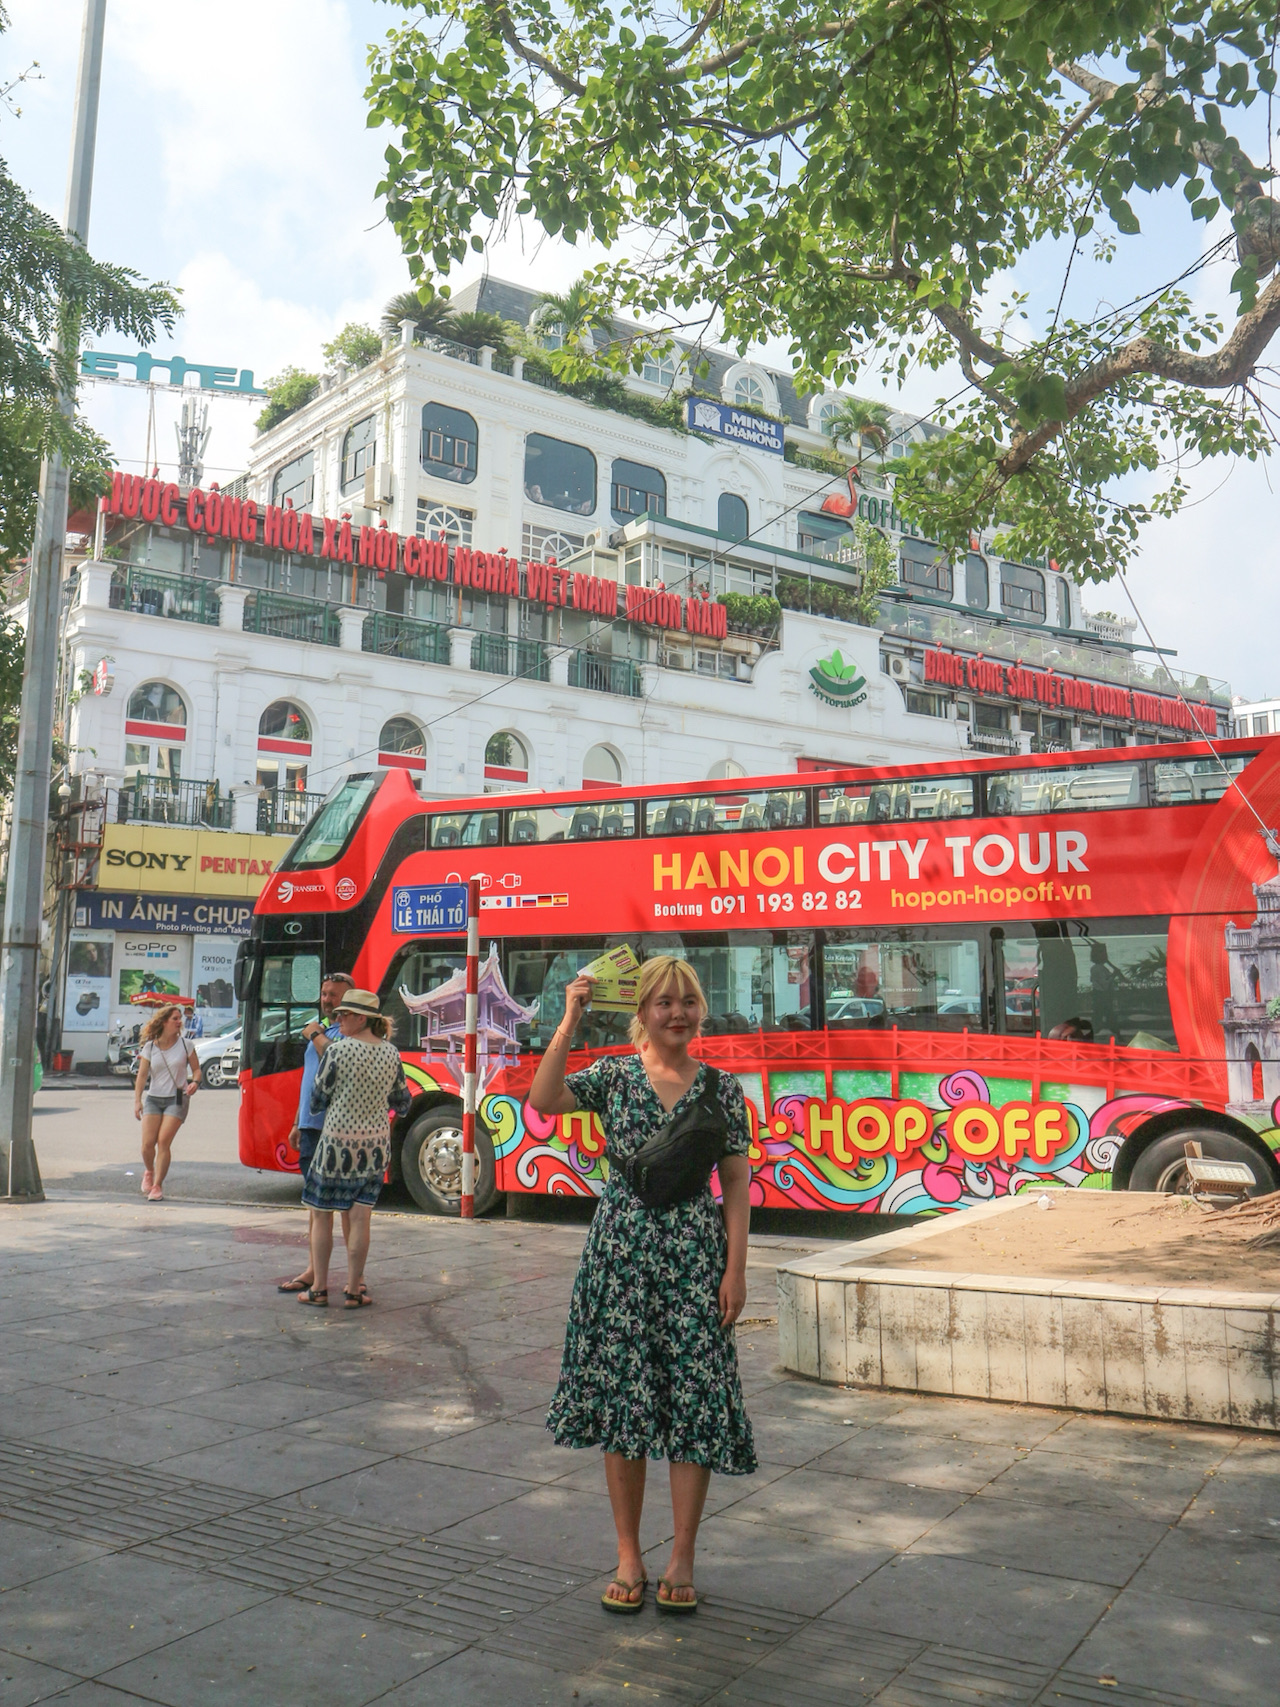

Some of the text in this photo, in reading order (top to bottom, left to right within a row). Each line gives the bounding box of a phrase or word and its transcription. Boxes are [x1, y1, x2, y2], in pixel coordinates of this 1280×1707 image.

[81, 351, 268, 395] ETTEL
[724, 423, 781, 449] DIAMOND
[731, 412, 776, 436] MINH
[187, 482, 258, 545] CỘNG
[264, 497, 314, 555] HÒA
[320, 512, 353, 563] XÃ
[359, 518, 399, 579] HỘI
[404, 529, 448, 582] CHỦ
[454, 546, 520, 597] NGHĨA
[526, 557, 571, 612] VIỆT
[572, 572, 618, 617] NAM
[626, 582, 681, 630] MUÔN
[686, 592, 727, 640] NĂM
[808, 683, 867, 708] PHYTOPHARCO
[967, 652, 1004, 697] CỘNG
[1006, 658, 1034, 700] SẢN
[1035, 667, 1062, 710] VIỆT
[1063, 678, 1091, 711] NAM
[1093, 684, 1132, 717] QUANG
[1132, 692, 1160, 723] VINH
[106, 849, 191, 871] SONY
[200, 856, 274, 876] PENTAX
[653, 830, 1089, 891] HANOI CITY TOUR
[419, 890, 442, 904] PHỐ
[710, 895, 747, 915] 091
[757, 893, 795, 913] 193
[801, 891, 828, 911] 82
[835, 890, 862, 909] 82
[891, 881, 1091, 910] hopon-hopoff.vn
[101, 900, 123, 919] IN
[130, 896, 178, 922] ẢNH
[193, 905, 250, 927] CHỤP
[399, 900, 463, 927] LÊ THÁI TỔ
[156, 922, 252, 936] Photo Printing and Taking
[125, 941, 177, 952] GoPro
[202, 956, 226, 964] RX100
[810, 1104, 927, 1163] HOP
[952, 1106, 1063, 1158] OFF
